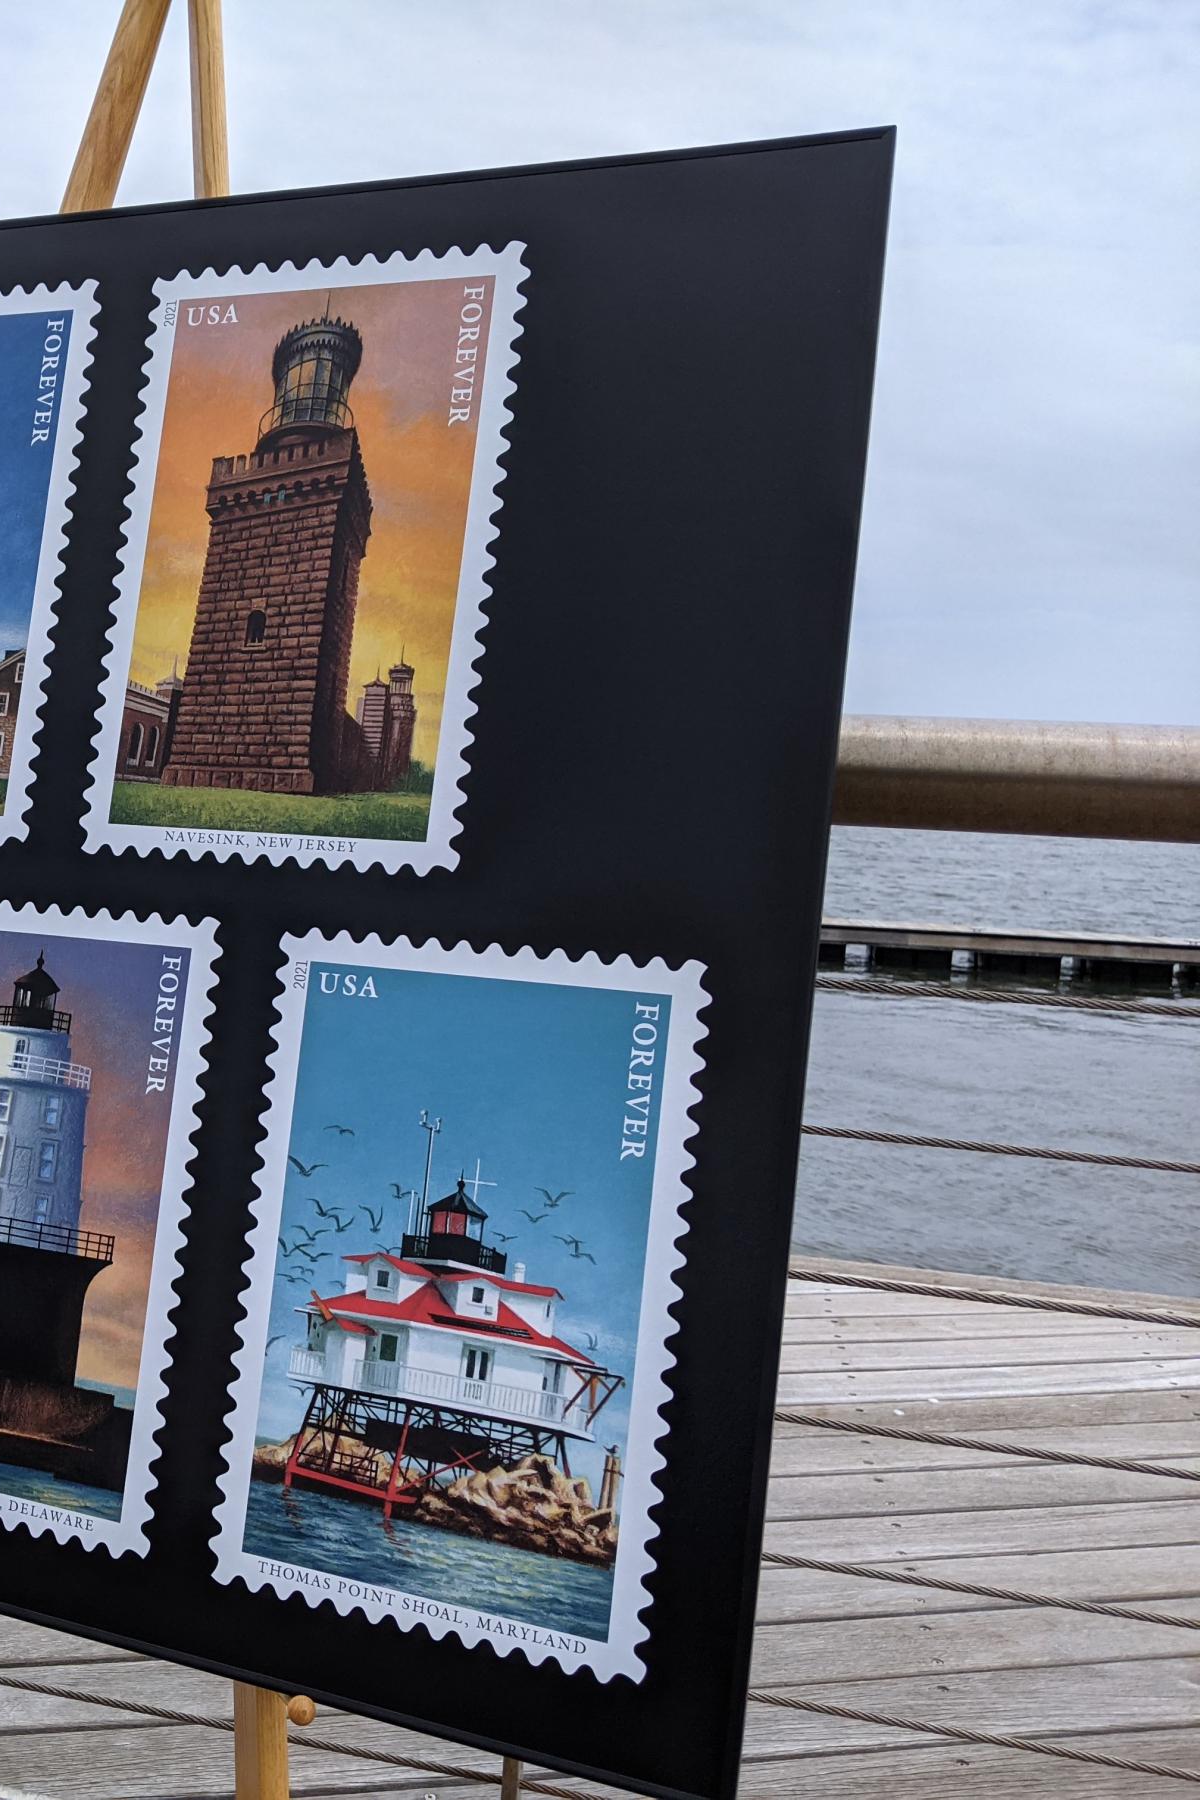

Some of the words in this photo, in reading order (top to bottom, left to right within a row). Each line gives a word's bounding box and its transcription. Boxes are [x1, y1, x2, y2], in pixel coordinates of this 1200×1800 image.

[163, 300, 178, 327] 2021
[186, 303, 239, 326] USA
[447, 284, 485, 427] FOREVER
[30, 317, 65, 447] FOREVER
[164, 830, 250, 848] NAVESINK,
[255, 836, 293, 848] NEW
[298, 838, 358, 853] JERSEY
[293, 960, 309, 990] 2021
[319, 972, 379, 998] USA
[145, 953, 182, 1095] FOREVER
[619, 1001, 660, 1161] FOREVER
[7, 1499, 95, 1532] DELAWARE
[257, 1560, 331, 1590] THOMAS
[337, 1580, 396, 1607] POINT
[401, 1597, 470, 1628] SHOAL,
[476, 1615, 587, 1655] MARYLAND
